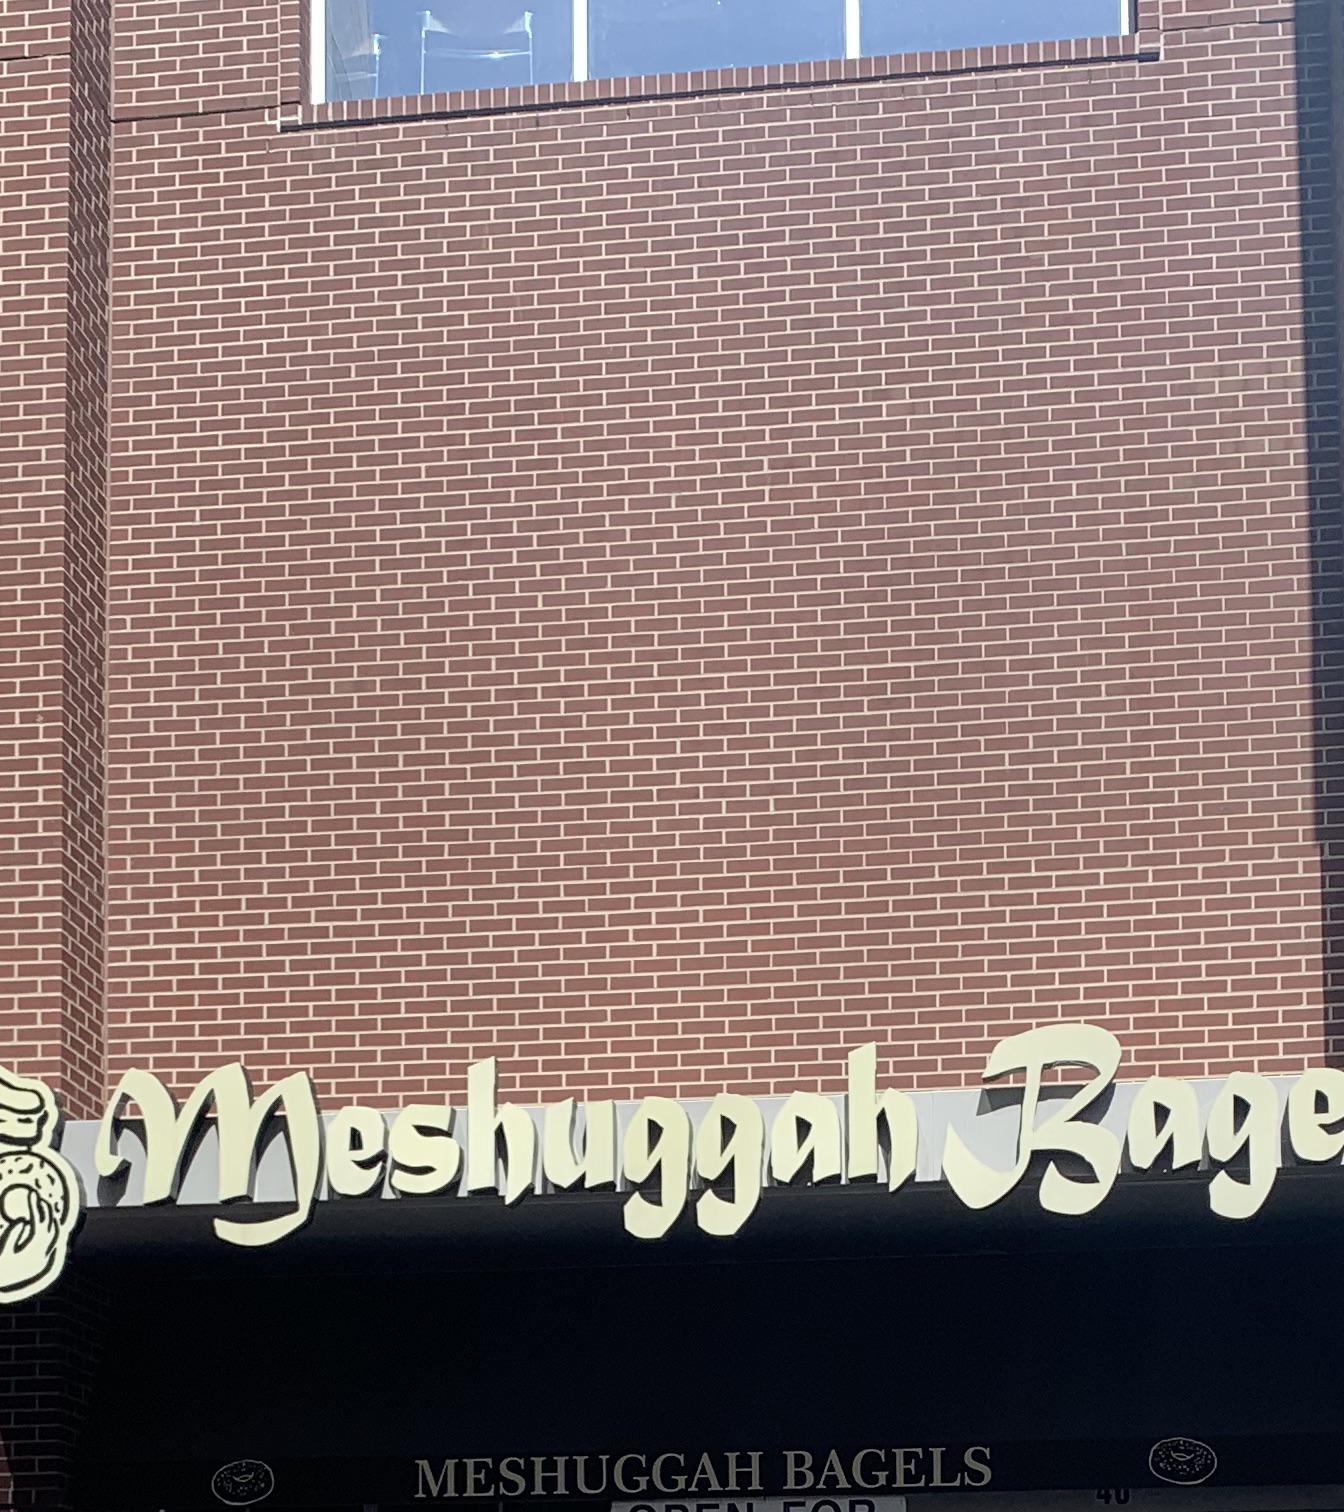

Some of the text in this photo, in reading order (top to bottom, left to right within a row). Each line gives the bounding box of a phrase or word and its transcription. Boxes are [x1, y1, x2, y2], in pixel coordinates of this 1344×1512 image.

[93, 1041, 918, 1247] Meshuggah
[414, 1446, 992, 1498] MESHUGGAH BAGELS
